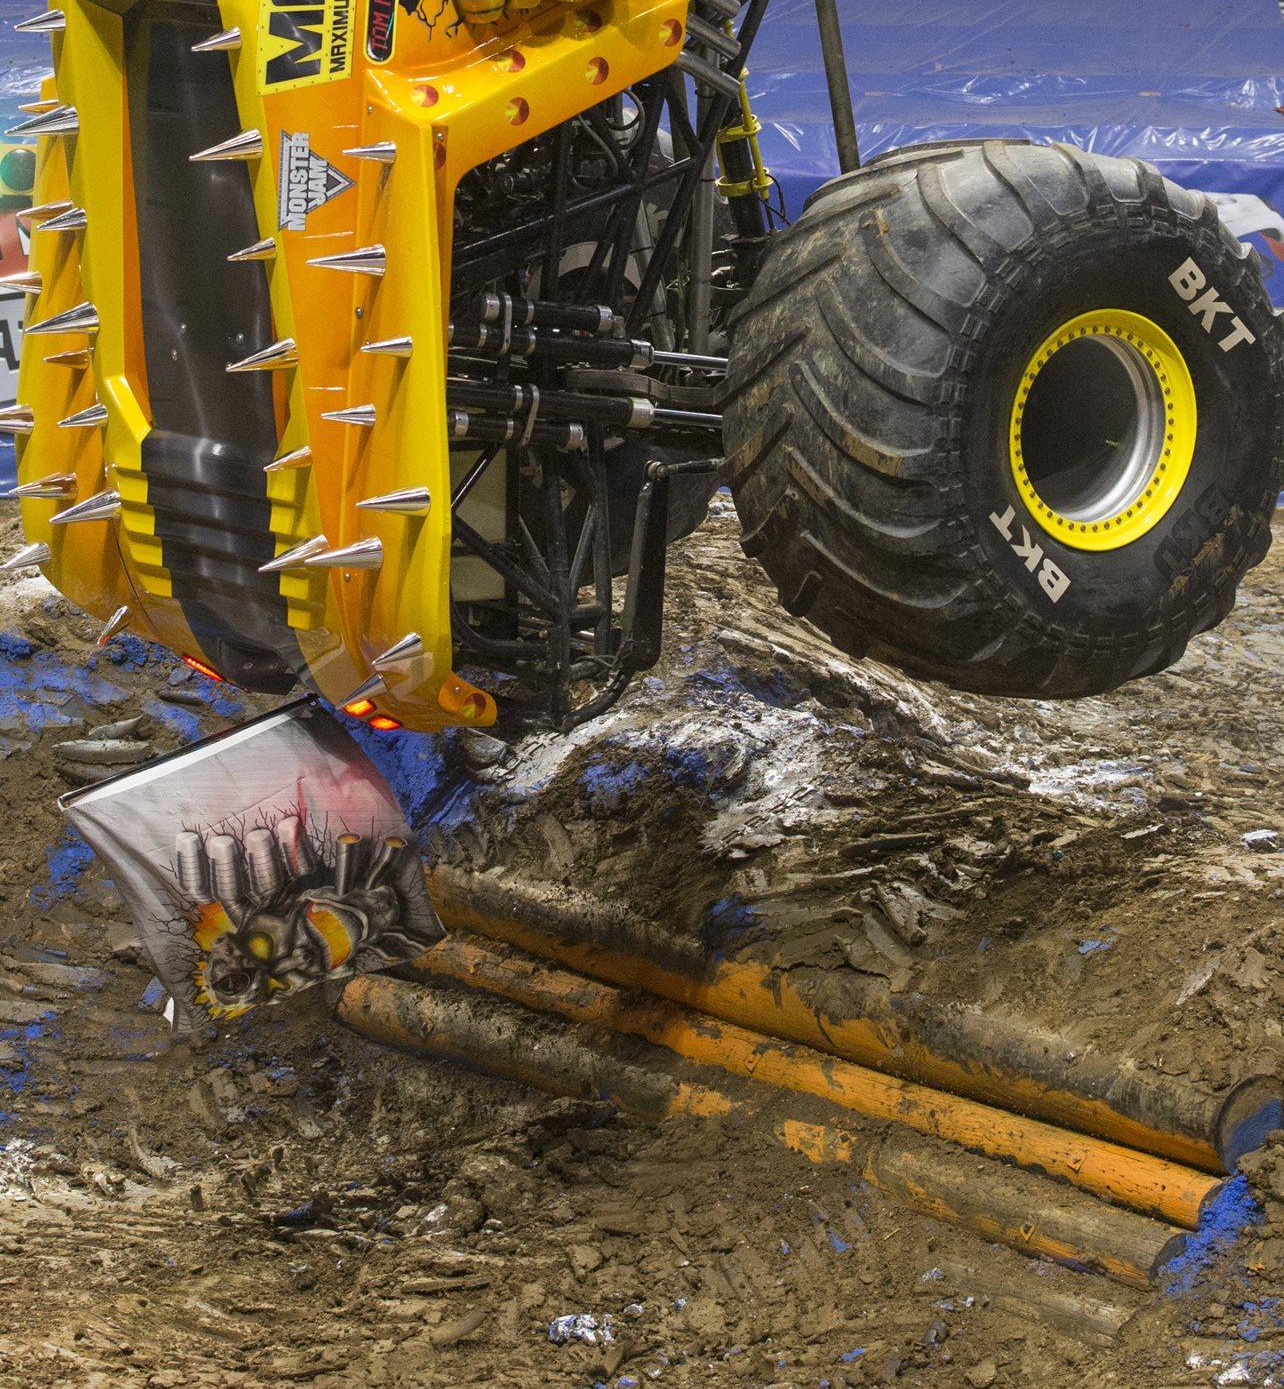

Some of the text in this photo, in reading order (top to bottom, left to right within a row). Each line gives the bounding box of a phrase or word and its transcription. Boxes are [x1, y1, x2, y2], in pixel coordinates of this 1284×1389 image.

[371, 12, 390, 50] TOM
[288, 131, 310, 231] MONSTER
[308, 158, 327, 205] JAM
[1167, 256, 1257, 353] BKT
[988, 504, 1072, 604] BKT
